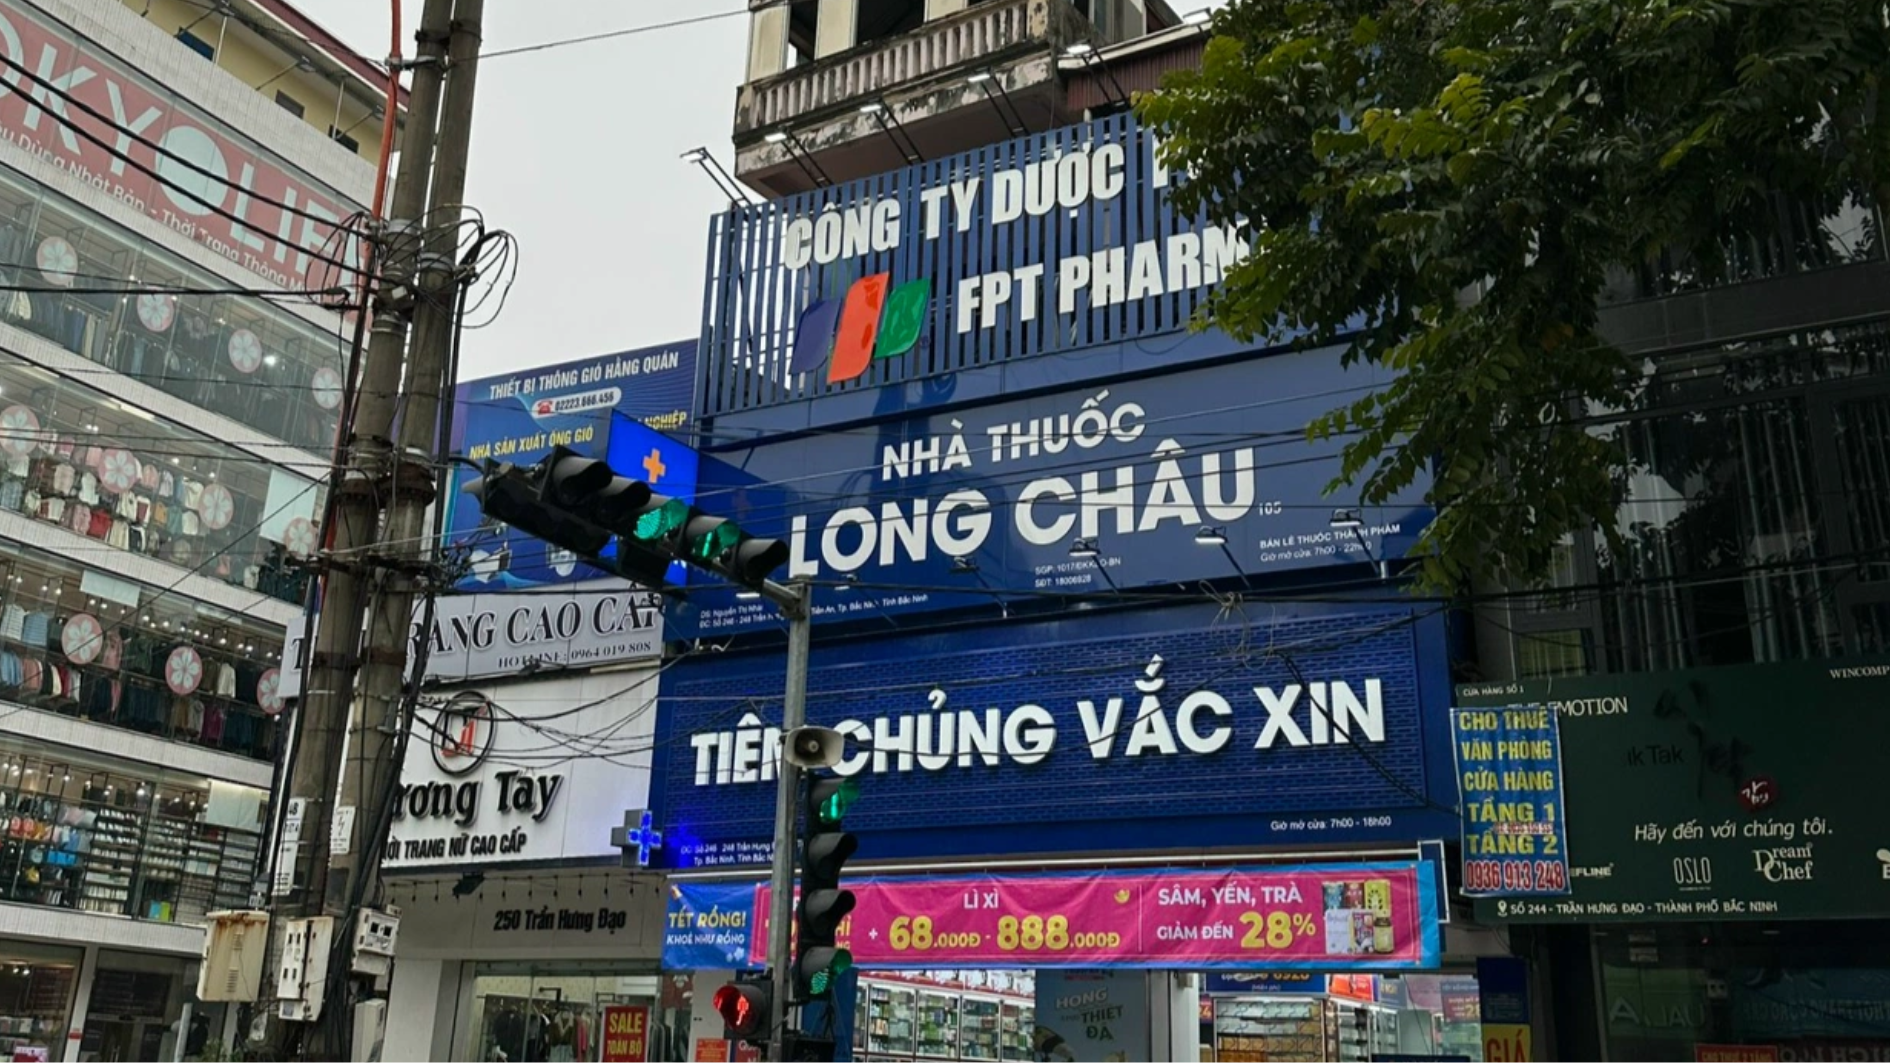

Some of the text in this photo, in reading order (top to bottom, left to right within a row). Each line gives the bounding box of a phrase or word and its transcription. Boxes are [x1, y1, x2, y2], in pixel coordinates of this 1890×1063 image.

[784, 199, 902, 271] CÔNG
[921, 175, 984, 240] TY
[991, 138, 1125, 226] DƯỢC
[957, 264, 1044, 334] FPT
[523, 376, 536, 396] BỊ
[882, 390, 1146, 481] NHÀ THUỐC
[788, 439, 1256, 579] LONG CHÂU
[1343, 540, 1373, 554] 22h0
[506, 600, 582, 645] CAO
[830, 688, 1058, 777] CHỦNG
[1077, 653, 1233, 760] VẮC
[1253, 678, 1387, 751] XIN
[1459, 706, 1551, 731] CHO THUÊ
[1461, 735, 1553, 761] VĂN PHÒNG
[1463, 766, 1555, 791] CỬA HÀNG
[1466, 795, 1556, 823] TẦNG 1
[1270, 819, 1288, 831] Giờ
[1330, 817, 1354, 829] 7h00
[1362, 815, 1393, 828] 18h00
[1634, 816, 1833, 844] Hãy đến với chúng tôi.
[405, 838, 445, 860] TRANG
[470, 834, 498, 856] CAO
[499, 825, 527, 854] CẤP
[1466, 830, 1559, 856] TẦNG 2
[1465, 860, 1565, 891] 0936 913 248
[1672, 856, 1713, 885] OSLO
[1764, 860, 1814, 882] Chef
[963, 889, 999, 909] LÌ XÌ
[1158, 881, 1303, 908] SÂM, YẾN, TRÀ
[1528, 904, 1548, 915] 244
[1657, 900, 1693, 914] THÀNH
[1696, 899, 1720, 913] PHỐ
[1750, 901, 1778, 912] NINH
[493, 909, 522, 931] 250
[1156, 911, 1316, 949] GIẢM ĐẾN 28%
[609, 1012, 643, 1034] SALE
